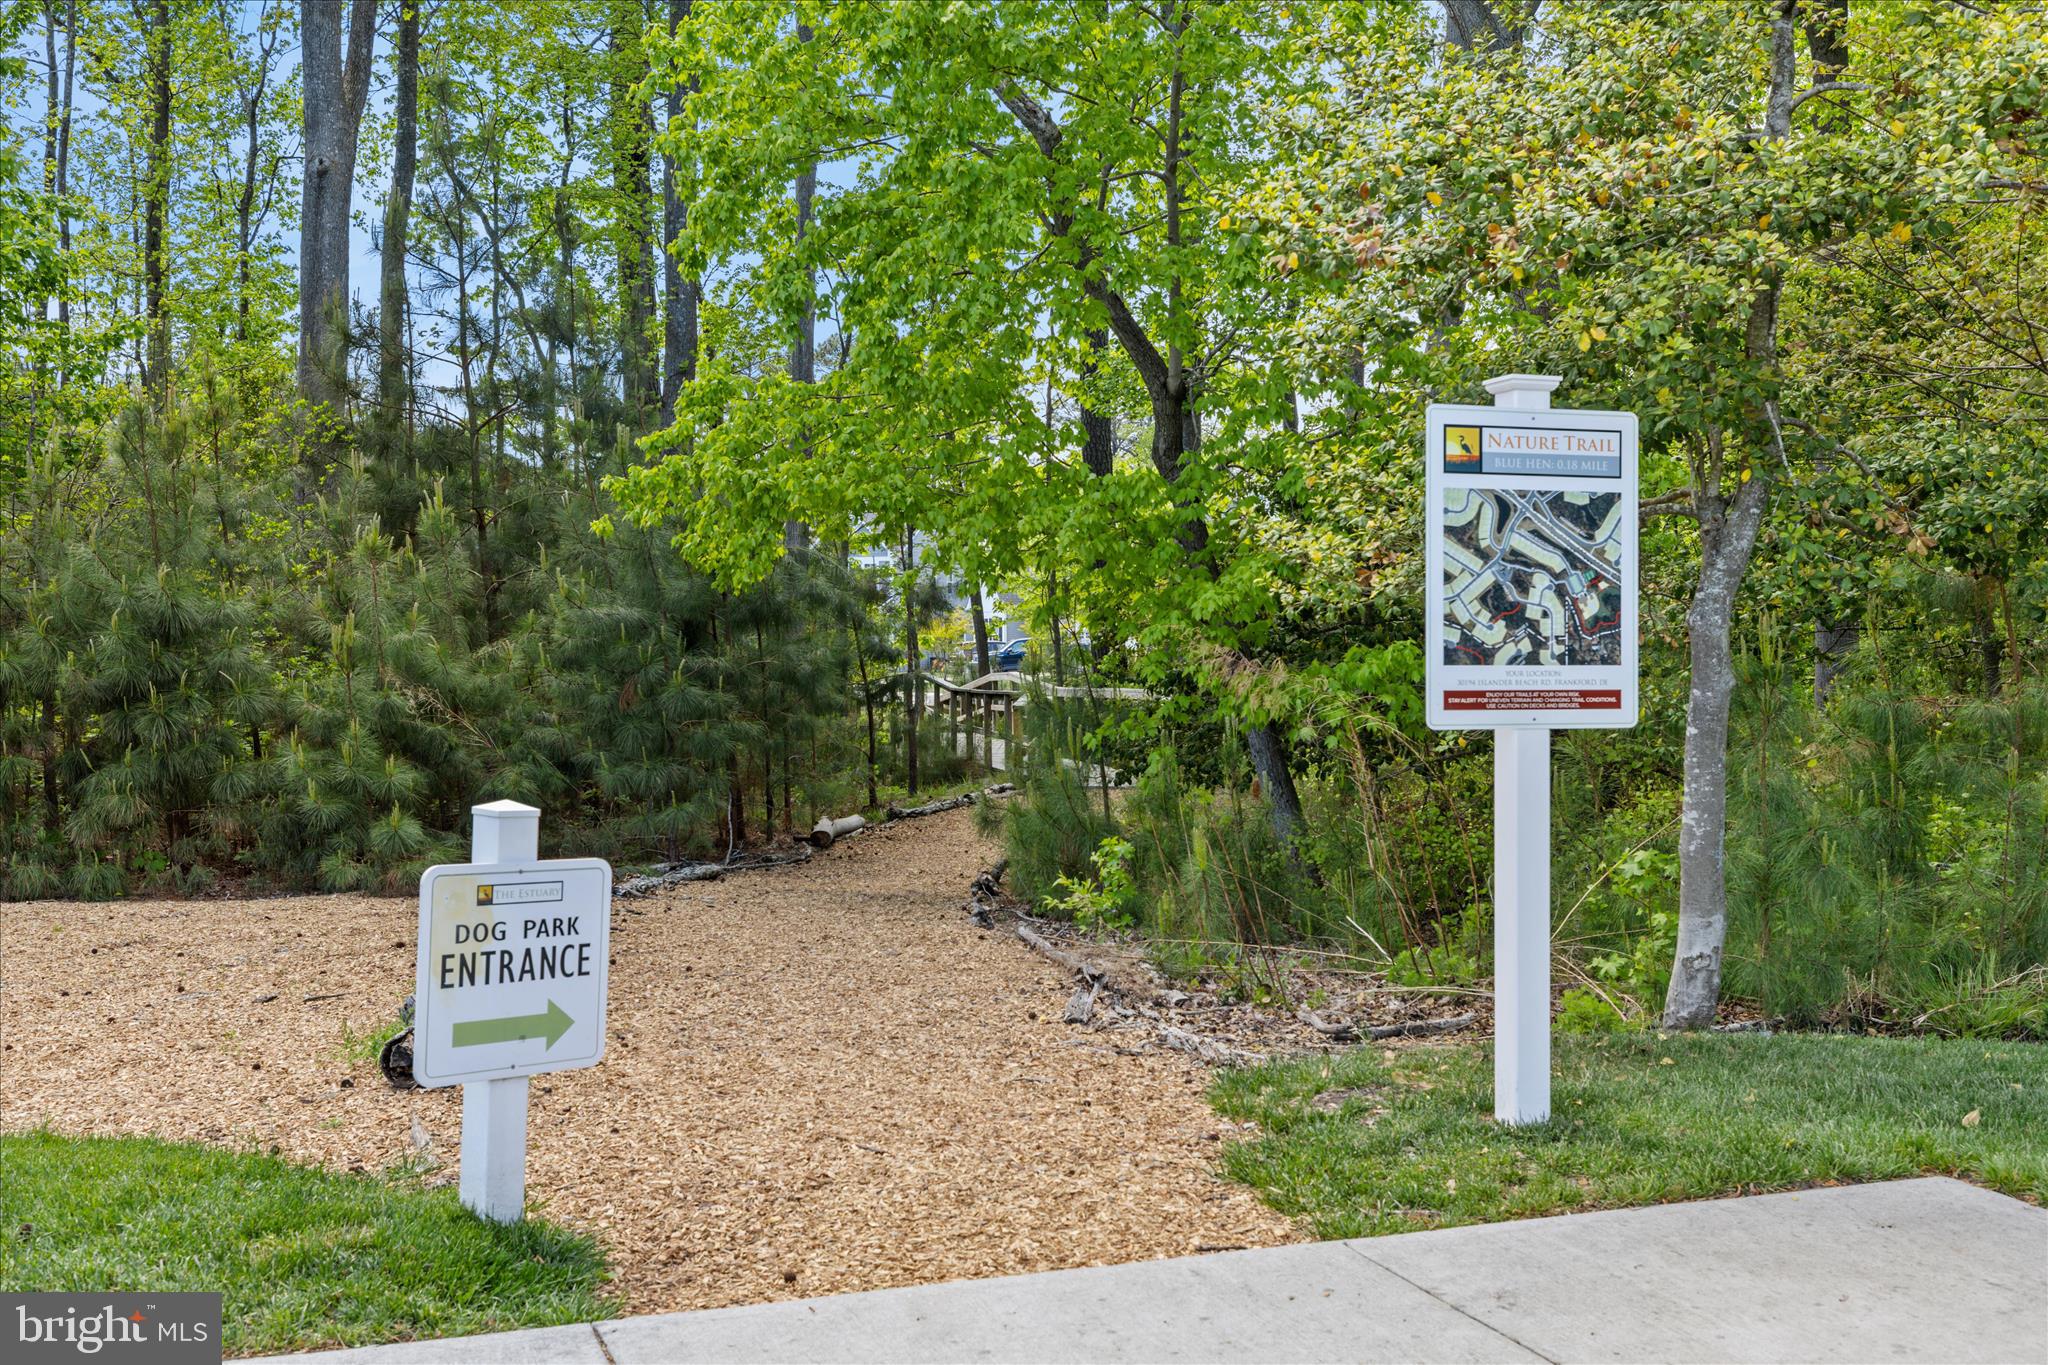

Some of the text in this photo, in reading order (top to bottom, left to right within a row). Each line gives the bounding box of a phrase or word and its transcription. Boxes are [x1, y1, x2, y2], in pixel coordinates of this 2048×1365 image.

[1488, 433, 1615, 452] NATURE TRAIL
[1495, 457, 1608, 471] BLUE HEN: 0.18 MILE
[495, 887, 561, 899] THE ESTUARY
[455, 916, 579, 944] DOG PARK
[440, 943, 591, 989] ENTRANCE
